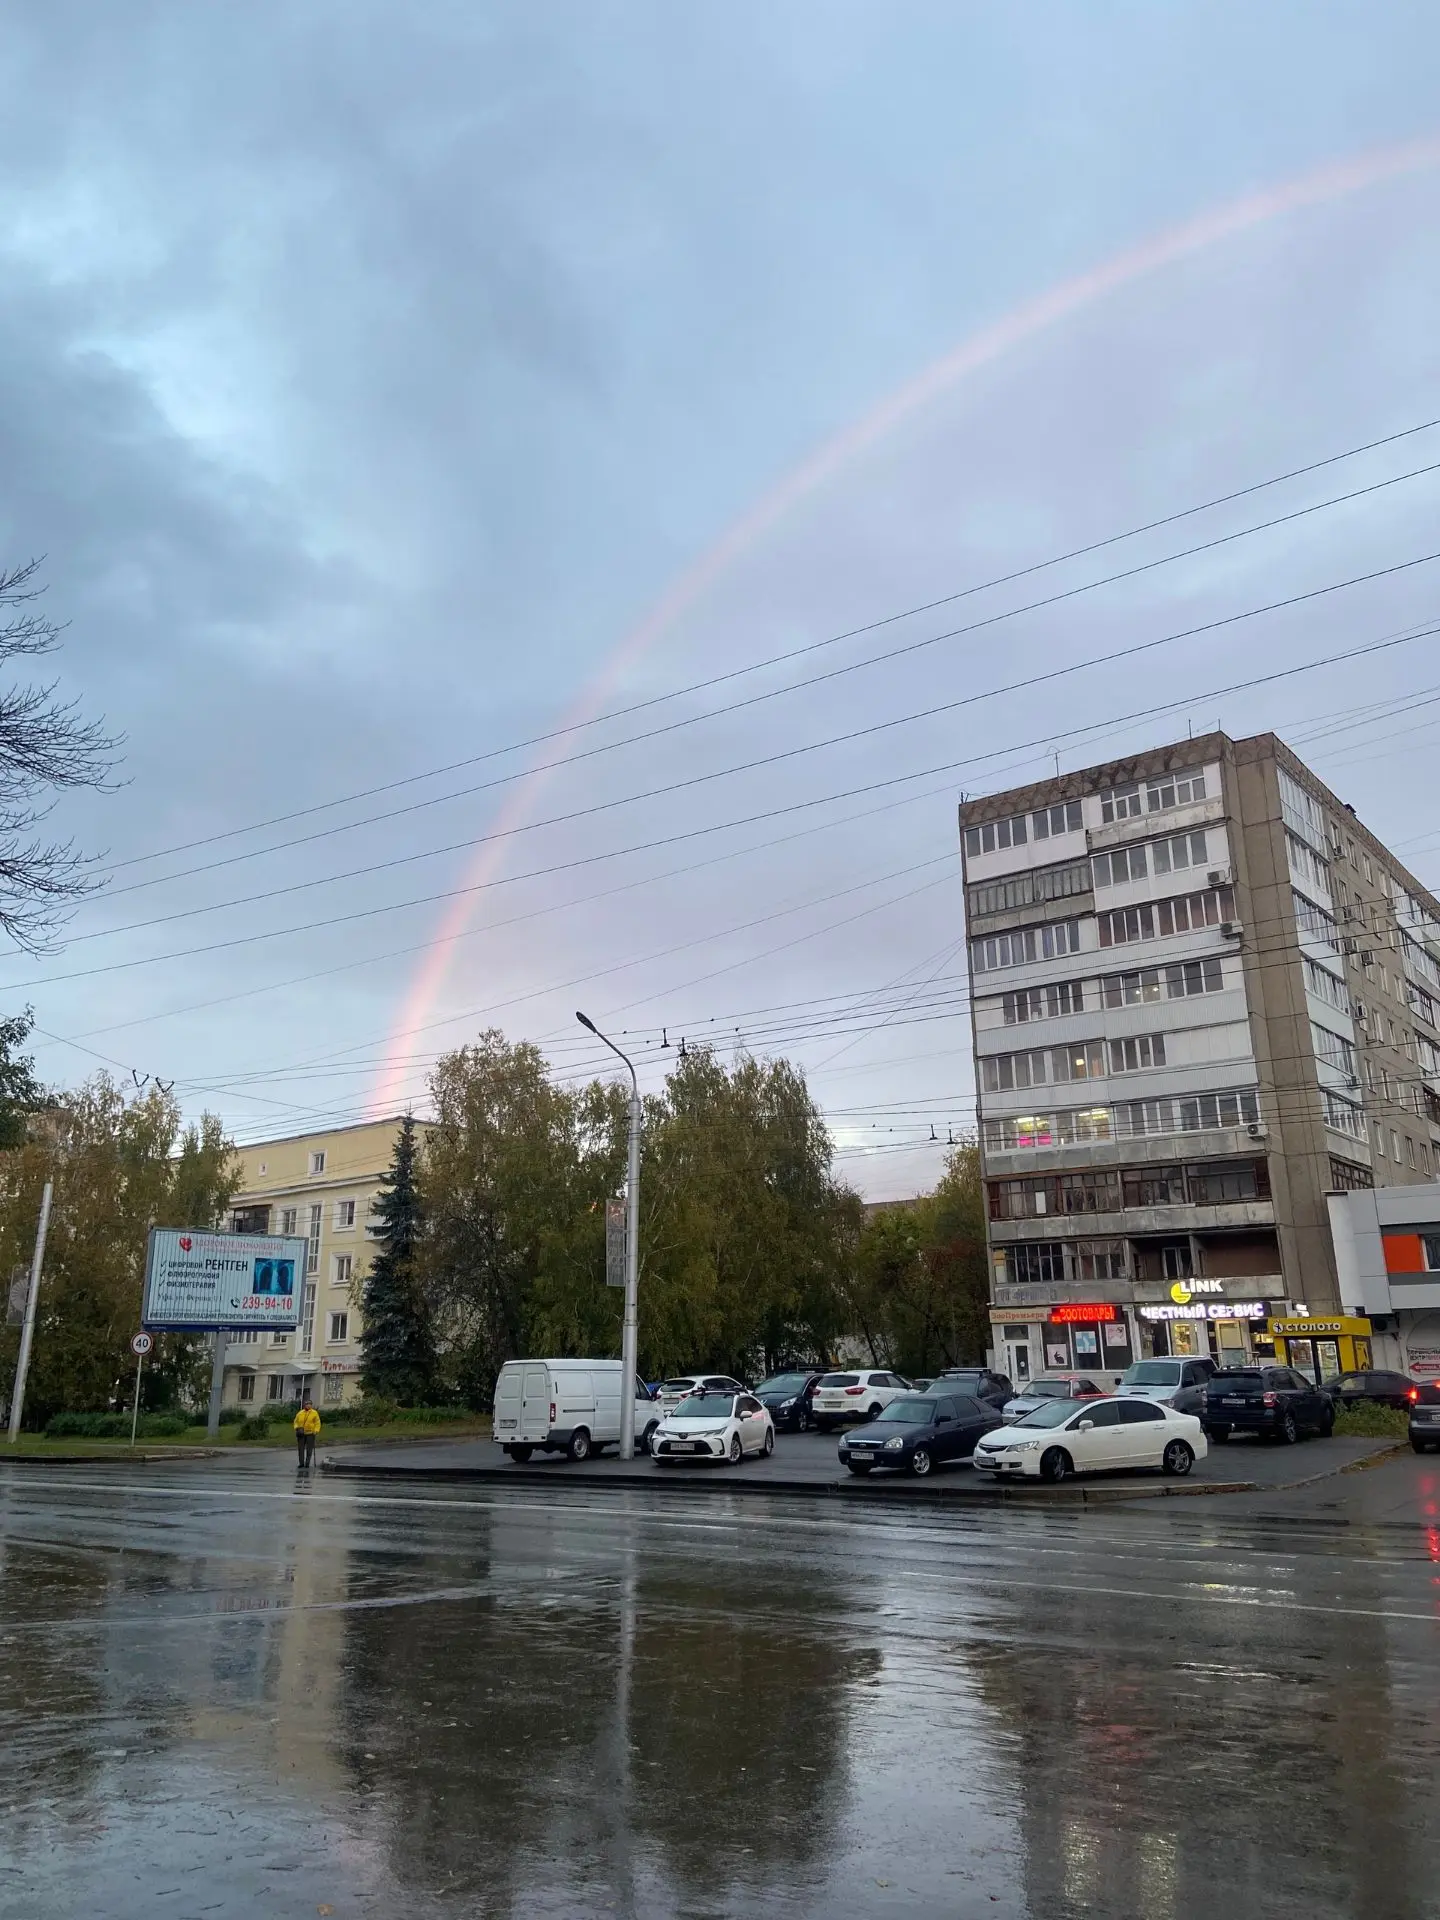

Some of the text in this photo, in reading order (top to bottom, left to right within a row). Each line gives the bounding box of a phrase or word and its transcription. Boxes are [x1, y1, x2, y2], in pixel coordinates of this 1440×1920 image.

[205, 1259, 248, 1271] РЕНТГЕН
[166, 1280, 216, 1289] ФИЗИОТЕРАПИЯ
[242, 1296, 293, 1310] 239-94-10
[1060, 1306, 1115, 1321] ЗООТОВАРЫ
[1140, 1302, 1264, 1319] ЧЕСТНЫЙ СЕРВИС
[1286, 1322, 1341, 1332] СТОЛОТО
[135, 1338, 148, 1348] 40
